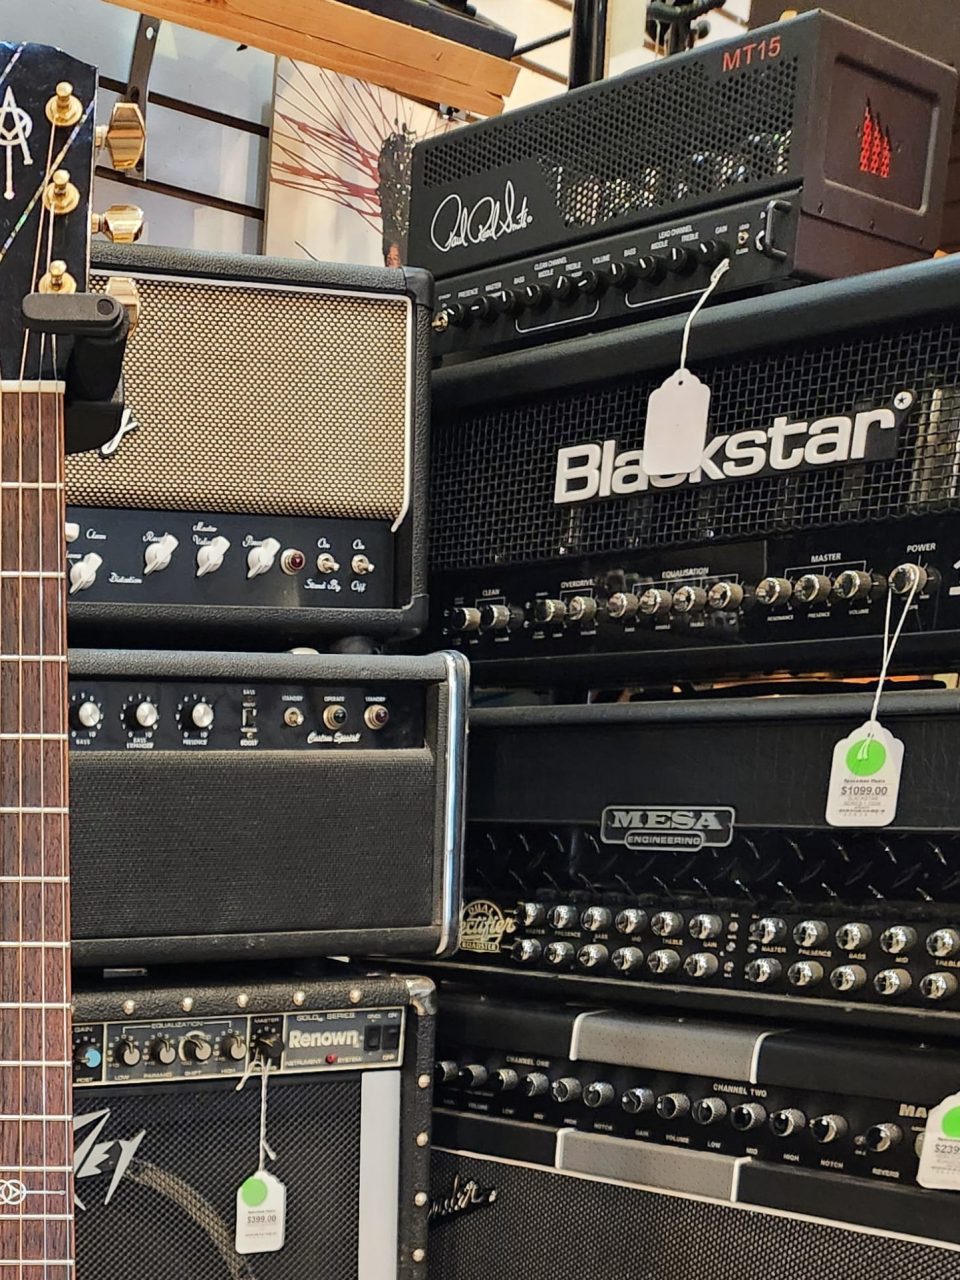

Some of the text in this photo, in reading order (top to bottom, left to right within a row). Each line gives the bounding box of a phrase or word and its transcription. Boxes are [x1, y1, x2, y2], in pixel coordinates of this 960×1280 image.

[723, 36, 780, 72] MT15
[554, 408, 896, 504] Blakstar
[907, 543, 936, 553] POWER
[811, 553, 841, 563] MASTER
[351, 580, 367, 593] Off
[841, 786, 888, 796] $1099.00
[611, 811, 723, 830] MESA
[627, 835, 701, 846] ENGINEERING
[461, 915, 516, 941] ectifier
[152, 1020, 203, 1029] EQUALIZATION
[289, 1029, 359, 1048] Renown
[506, 1055, 535, 1066] CHANNEL
[713, 1083, 767, 1098] CHANNEL TWO
[666, 1135, 690, 1144] VOLUME
[707, 1141, 722, 1149] LOW
[820, 1159, 843, 1169] NOTCH
[247, 1215, 277, 1224] $399.00
